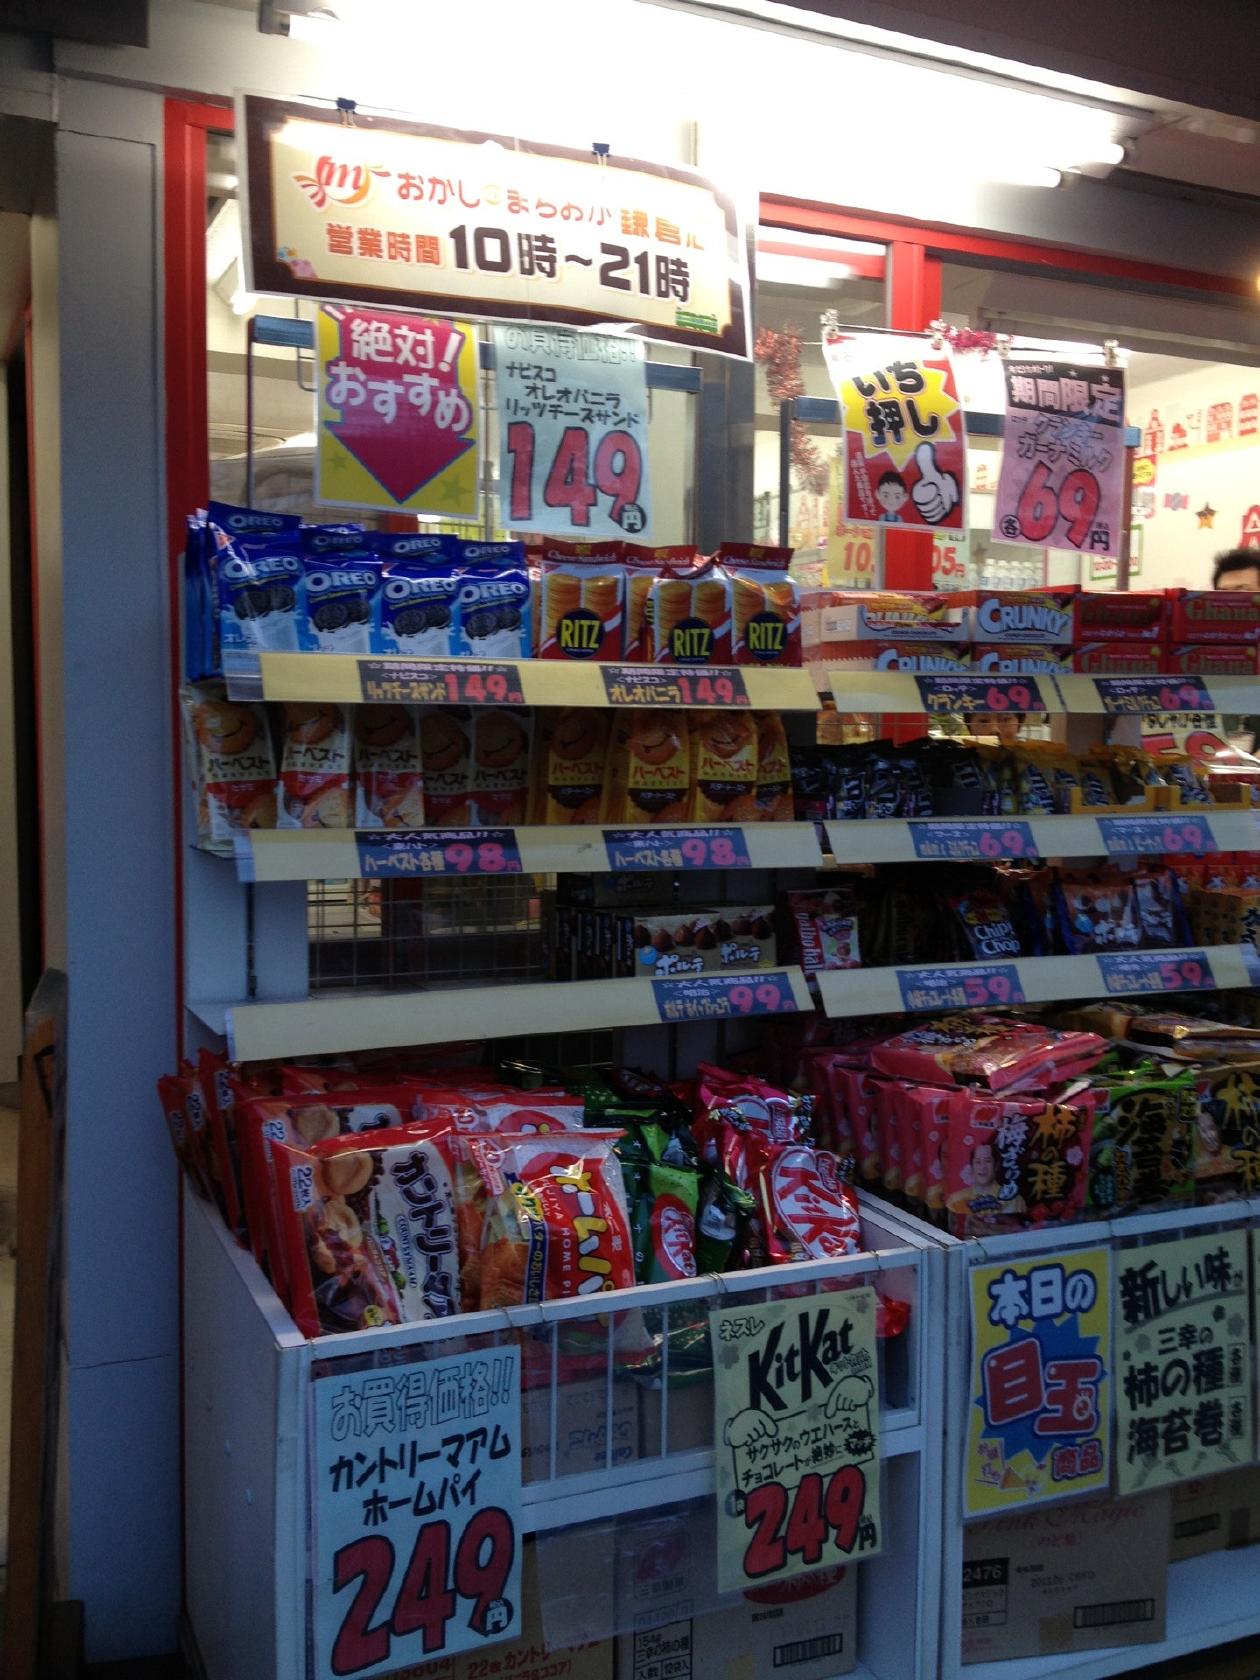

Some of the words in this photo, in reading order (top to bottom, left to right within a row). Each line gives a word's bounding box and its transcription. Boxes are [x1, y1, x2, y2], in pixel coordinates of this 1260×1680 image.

[325, 222, 441, 267] 営業時間
[350, 317, 463, 373] 絶対!
[505, 360, 558, 383] ナビスコ
[852, 360, 924, 398] いち
[329, 360, 471, 432] おすすめ
[524, 382, 622, 409] オレオバニラ
[1010, 374, 1124, 422] 期間限定
[505, 397, 640, 428] リッツチーズサンド
[867, 398, 940, 446] 押し
[227, 514, 285, 529] OREO
[394, 536, 442, 553] OREO
[464, 544, 511, 558] OREO
[223, 555, 300, 580] OREO
[305, 571, 377, 593] OREO
[384, 578, 458, 600] OREO
[460, 581, 529, 603] OREO
[979, 598, 1071, 636] CRUNKY
[560, 619, 601, 649] RITZ
[673, 627, 711, 657] RITZ
[748, 622, 784, 650] RITZ
[609, 684, 681, 703] オレオバニラ
[208, 755, 271, 773] ハーベスト
[357, 748, 418, 763] ハーベスト
[552, 761, 608, 775] ハーベスト
[702, 757, 755, 772] ハーベスト
[424, 772, 470, 786] ーベスト
[475, 767, 528, 782] ハーベスト
[633, 766, 686, 781] ハーベスト
[655, 952, 705, 977] ポルテ
[720, 942, 761, 966] ポルテ
[1026, 1103, 1079, 1201] 柿の種
[562, 1227, 573, 1273] HOME
[988, 1263, 1097, 1330] 本日の
[1119, 1246, 1233, 1325] 新しい味
[719, 1315, 766, 1342] ネスレ
[1157, 1323, 1215, 1356] 三幸の
[748, 1308, 855, 1411] KitKat
[983, 1335, 1104, 1438] 目玉
[1123, 1346, 1227, 1412] 柿の種
[330, 1355, 515, 1442] お買得価格!!
[1127, 1398, 1227, 1465] 海苔巻
[328, 1424, 512, 1493] カントリーマアム
[1052, 1438, 1104, 1483] 商品
[362, 1468, 482, 1527] ホームパイ
